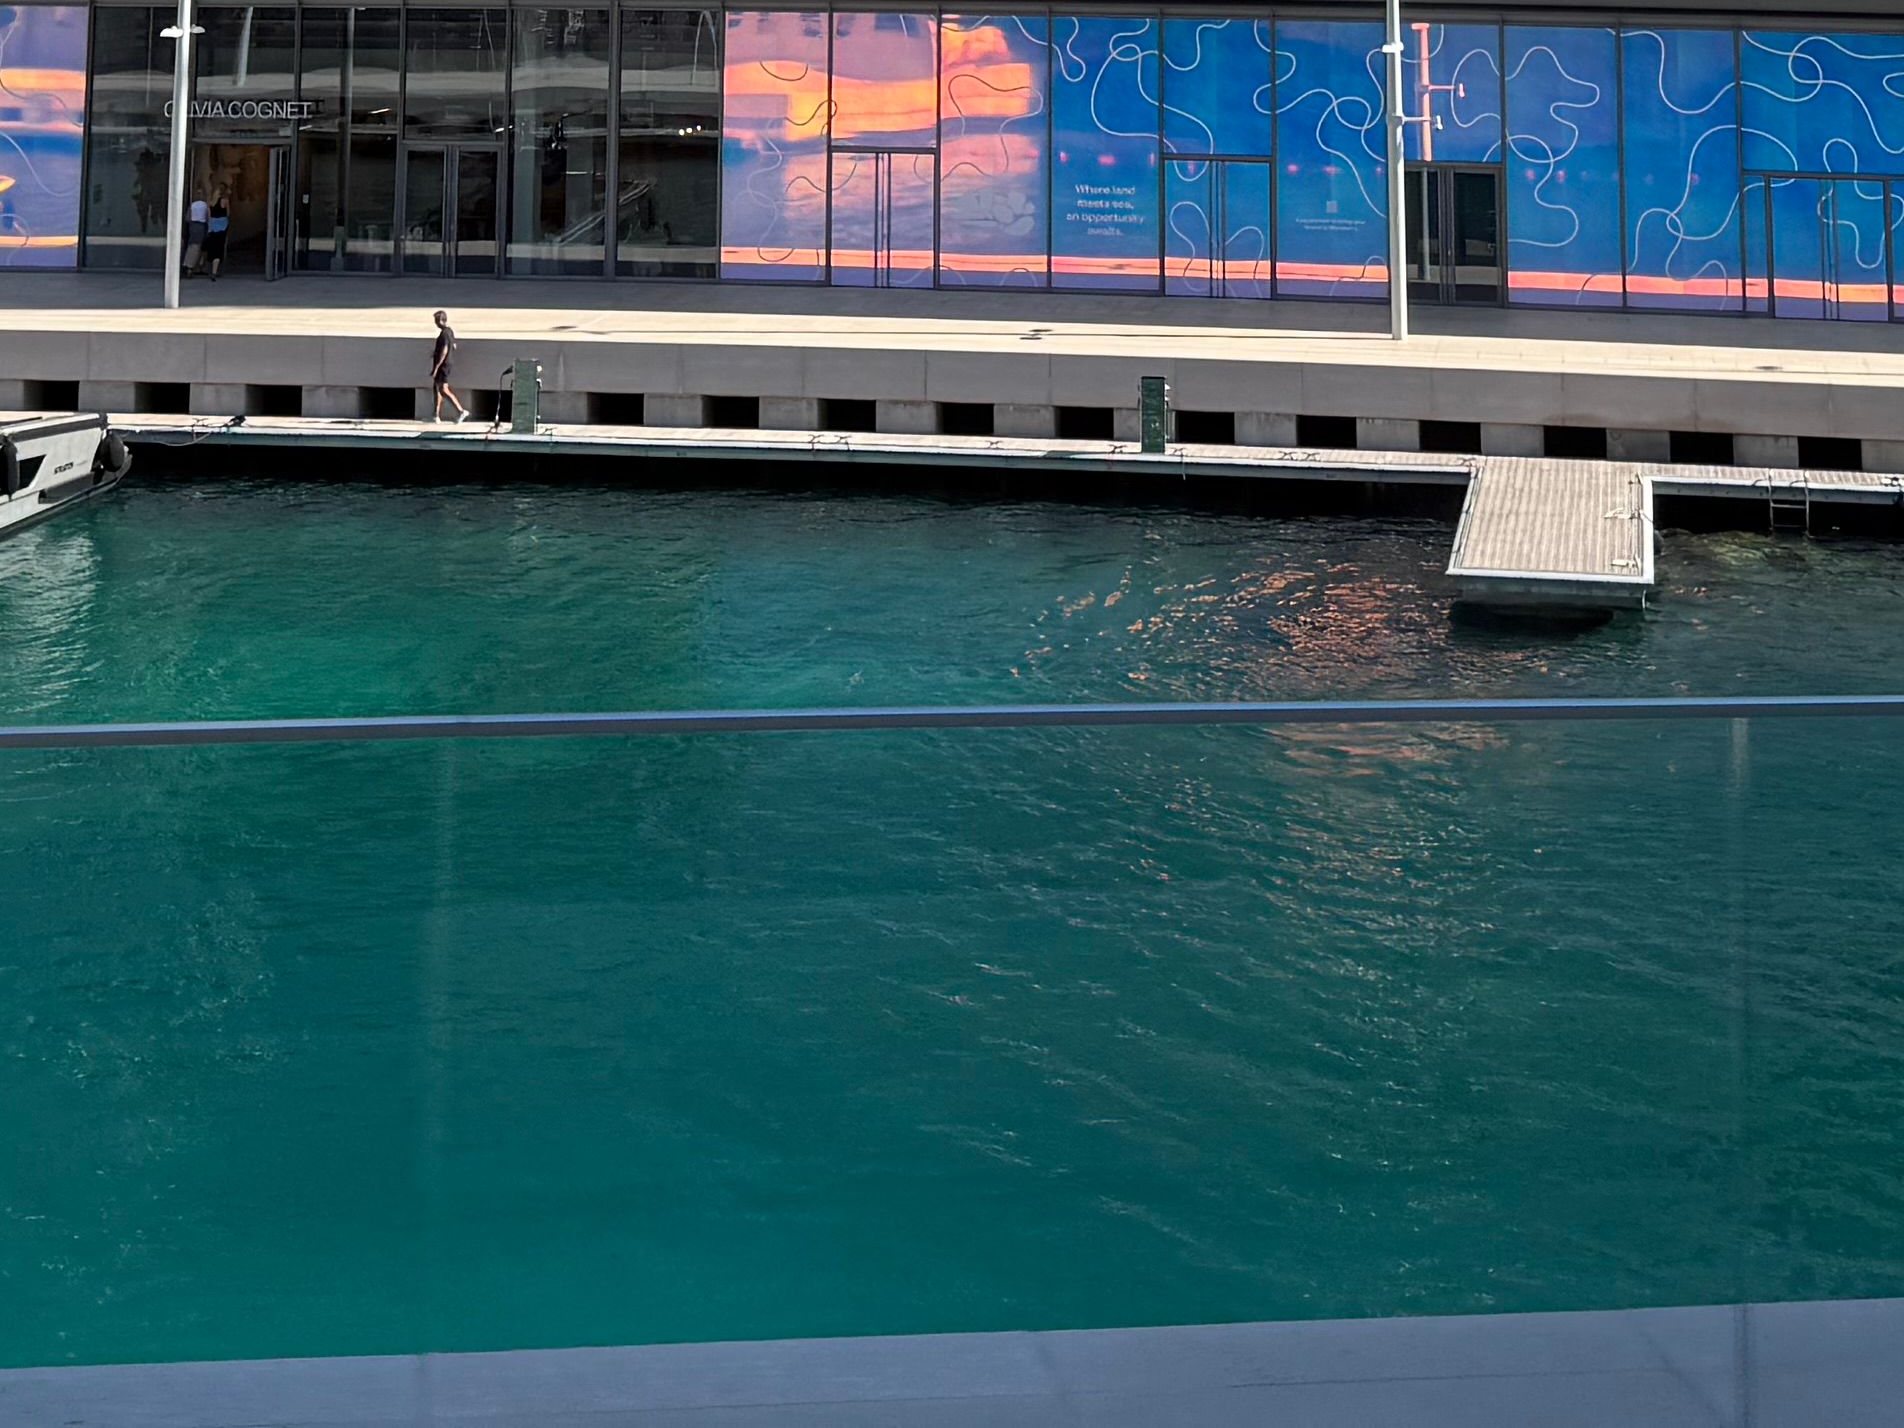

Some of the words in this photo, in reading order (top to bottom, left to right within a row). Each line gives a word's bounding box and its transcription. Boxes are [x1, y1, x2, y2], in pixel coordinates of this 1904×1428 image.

[164, 100, 225, 118] OIVIA
[228, 101, 312, 119] COGNET
[1075, 184, 1110, 194] Where
[1081, 212, 1144, 223] opportunity
